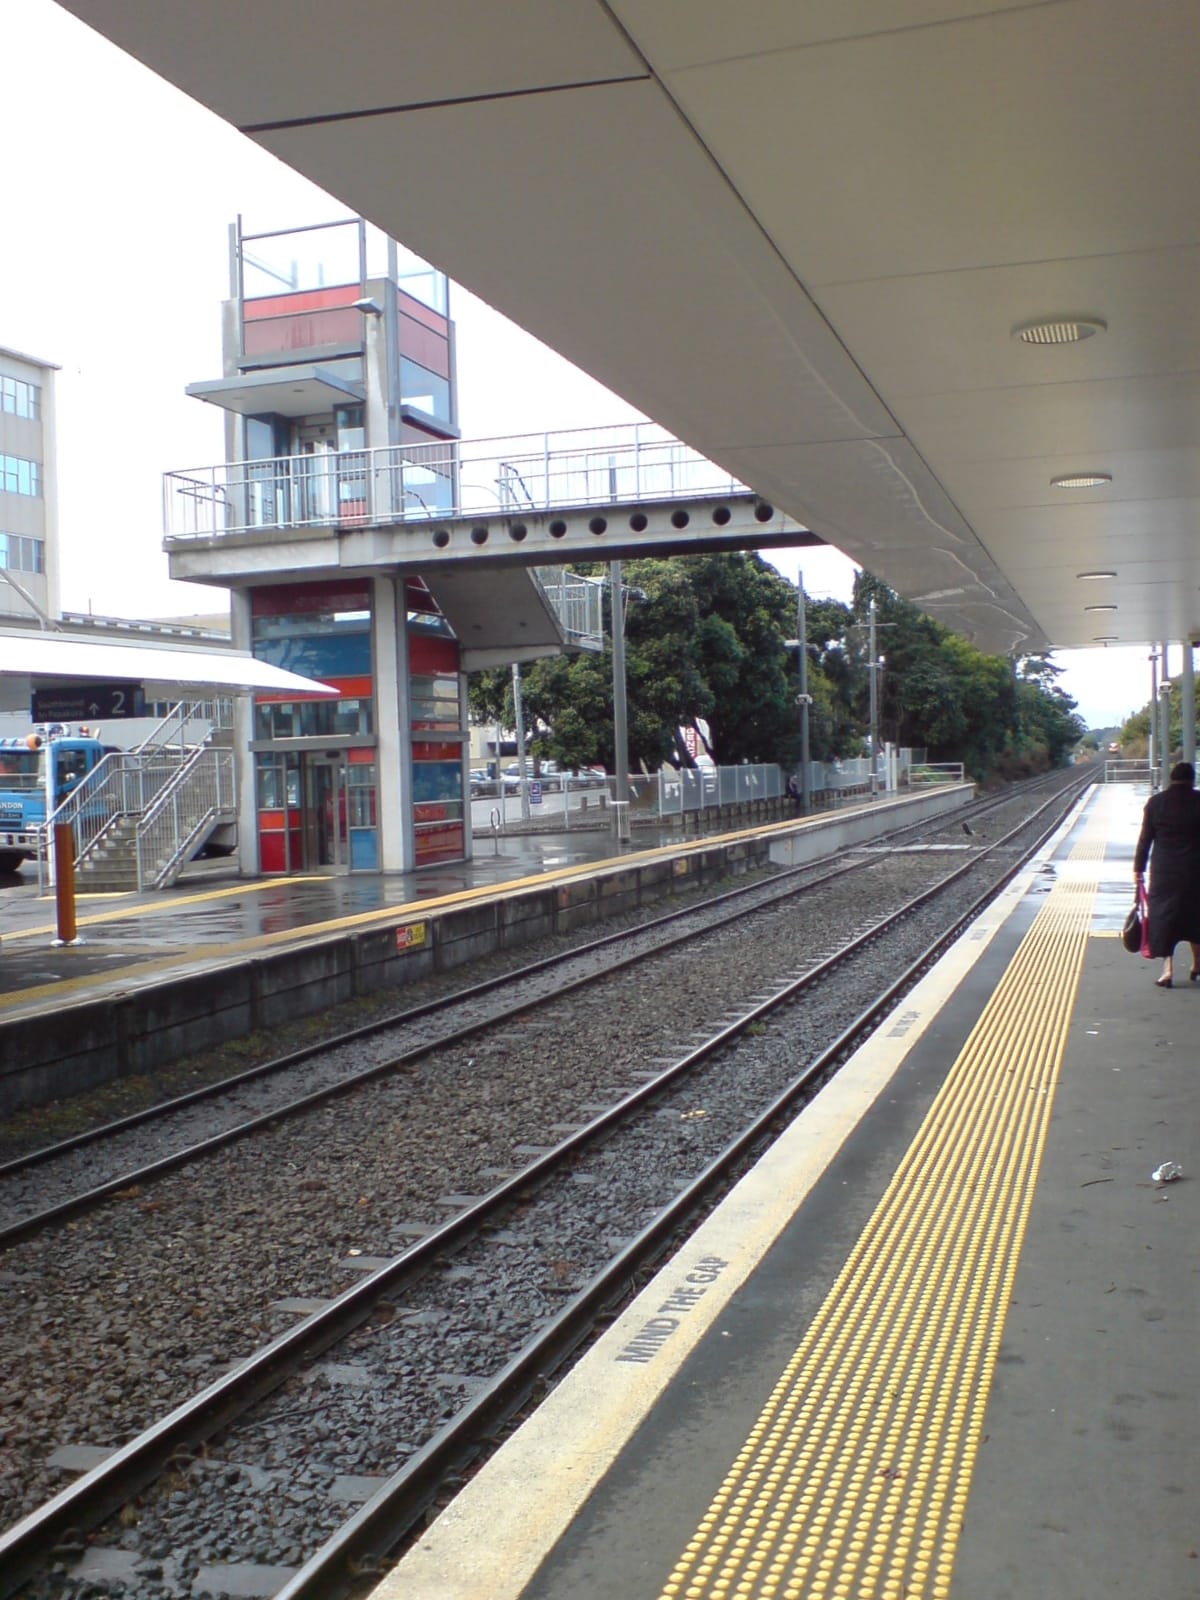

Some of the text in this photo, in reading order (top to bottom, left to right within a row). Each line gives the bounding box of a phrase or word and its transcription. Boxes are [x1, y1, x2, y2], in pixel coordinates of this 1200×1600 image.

[111, 690, 126, 714] 2
[614, 1256, 729, 1363] MIND THE GAP
